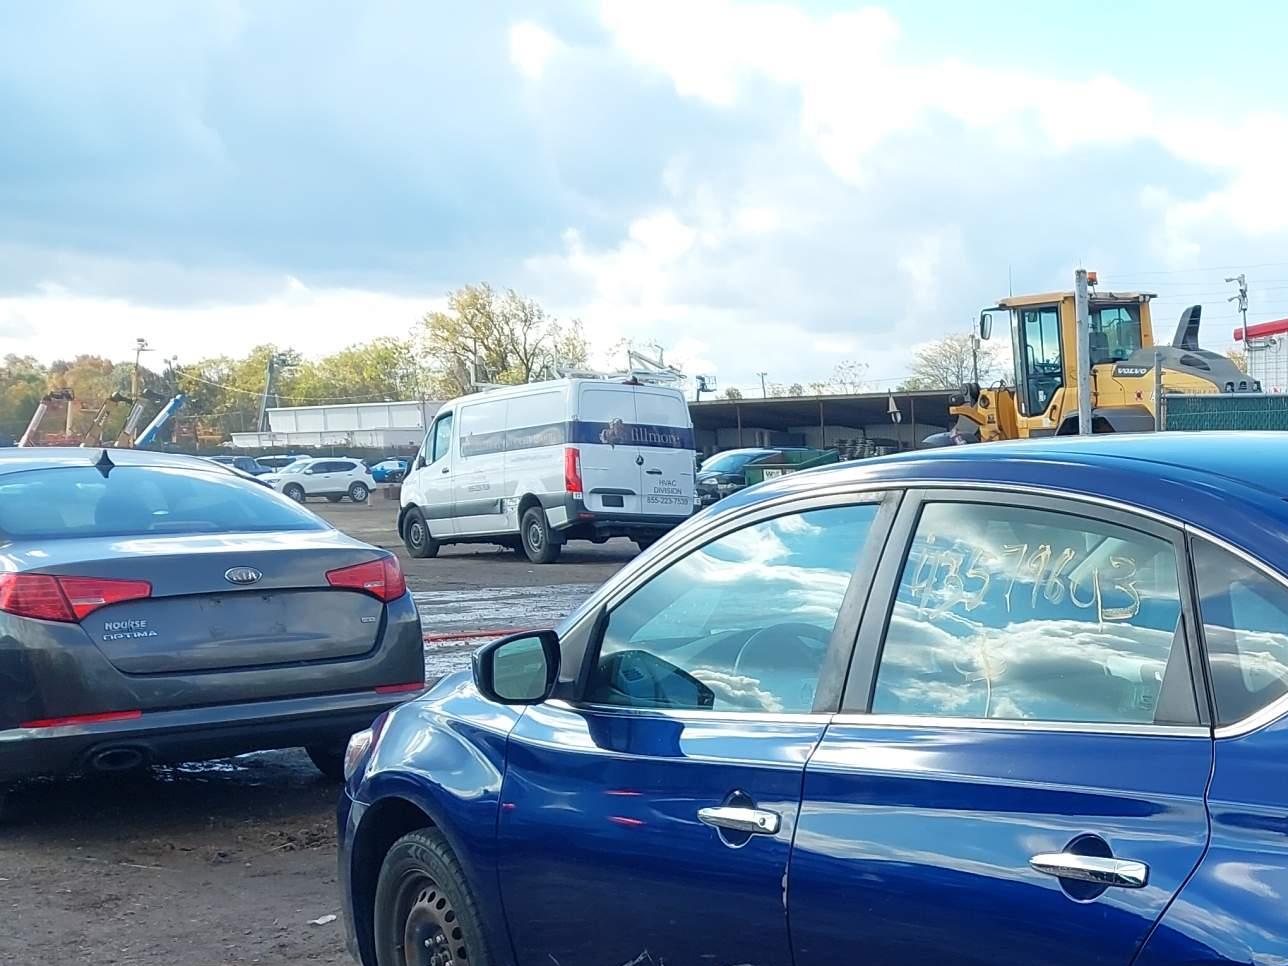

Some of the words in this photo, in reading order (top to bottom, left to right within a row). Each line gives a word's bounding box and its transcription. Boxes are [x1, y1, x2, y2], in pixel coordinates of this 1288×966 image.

[1117, 367, 1147, 375] VOLVO
[658, 479, 677, 487] HVAC
[653, 486, 682, 495] DIVISION
[230, 568, 258, 582] KIA
[104, 619, 148, 631] NOURSE
